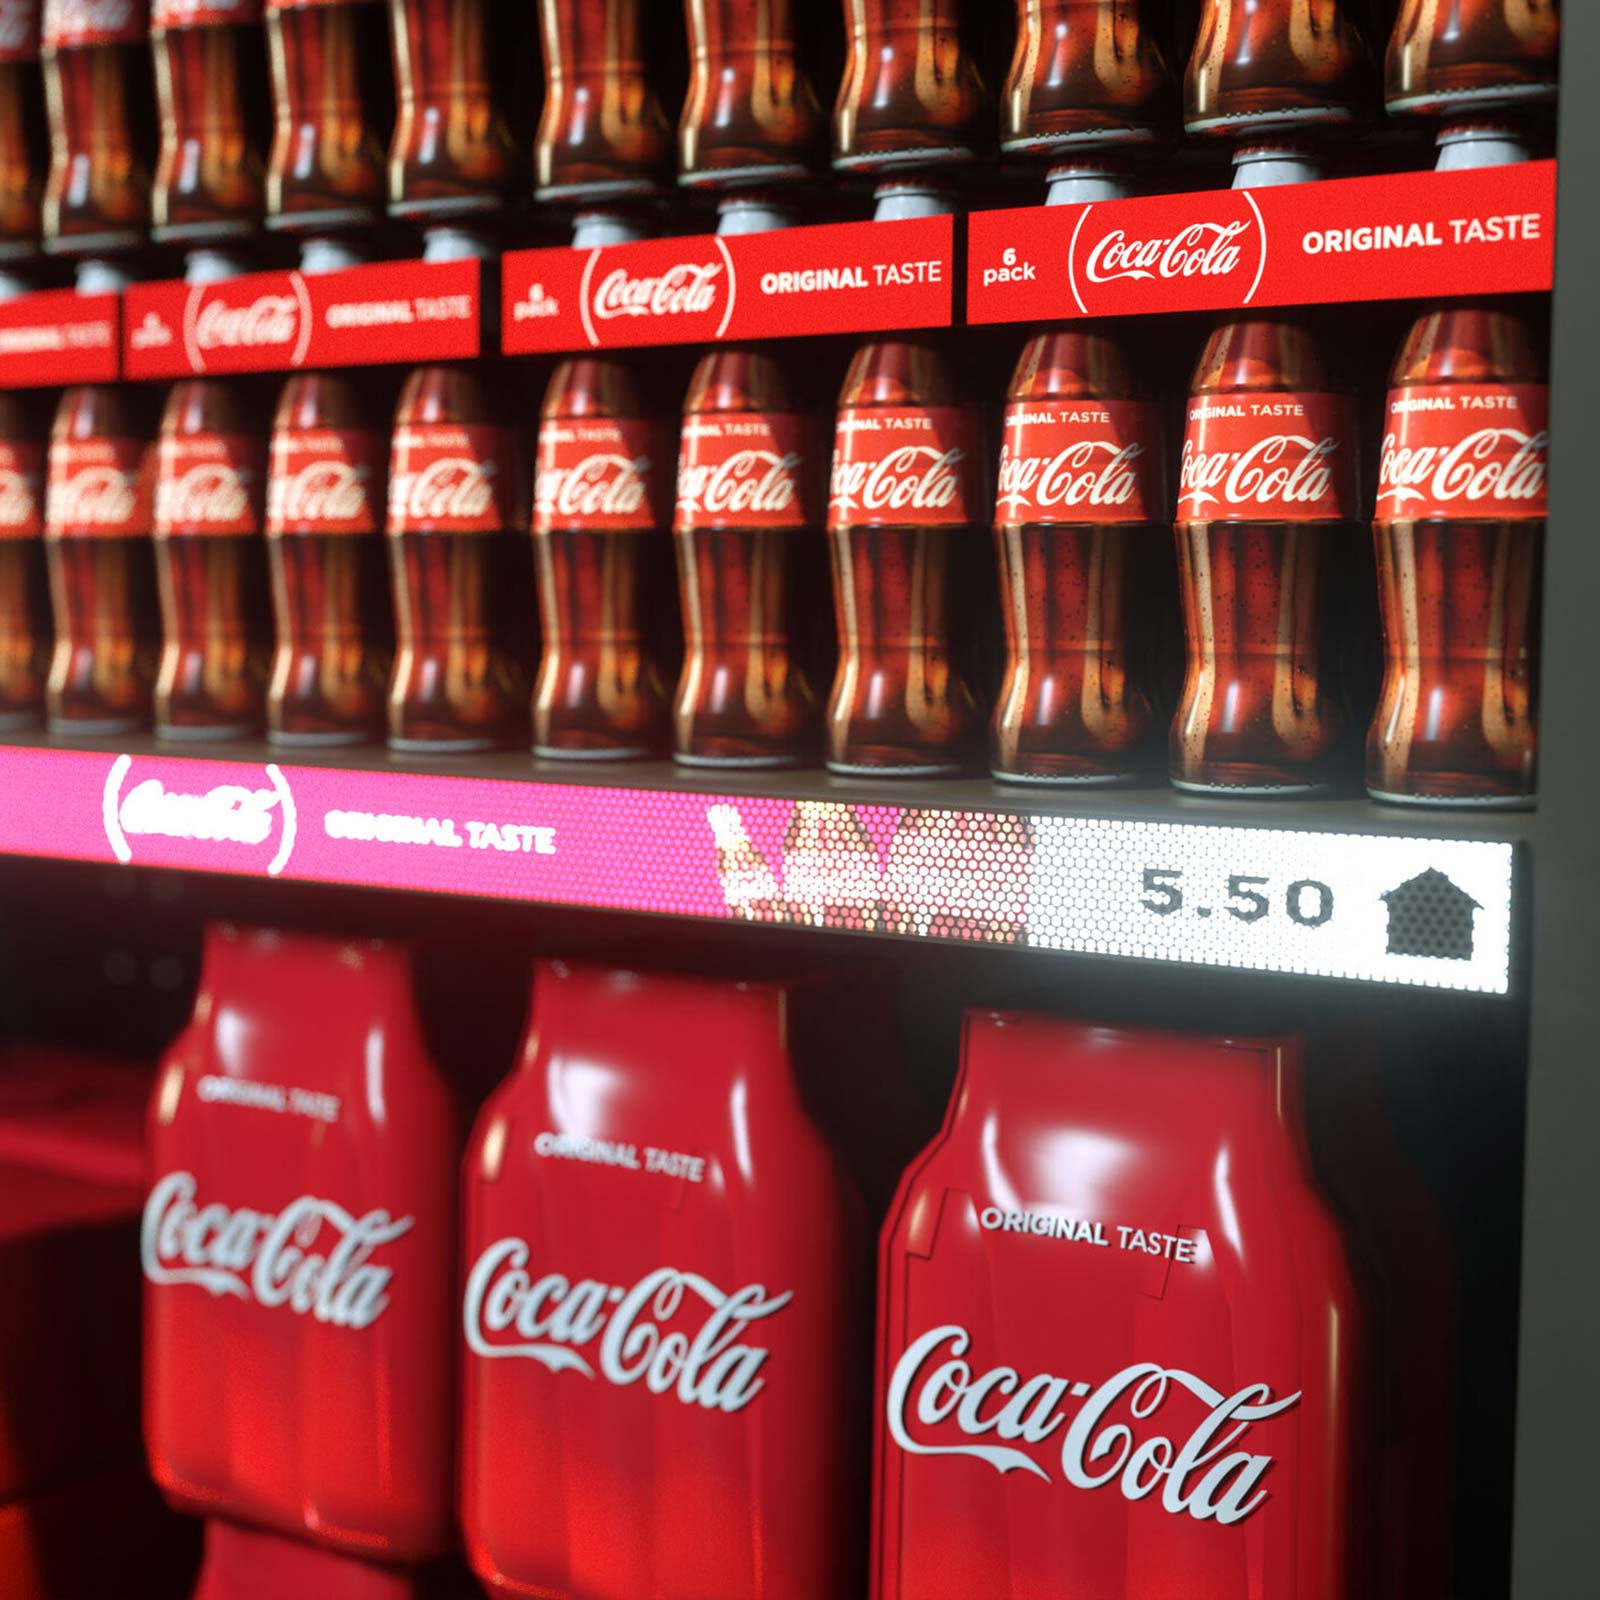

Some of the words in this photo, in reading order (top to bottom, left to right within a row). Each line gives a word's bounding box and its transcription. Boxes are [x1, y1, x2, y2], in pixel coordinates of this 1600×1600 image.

[1086, 220, 1251, 283] Coca-Cola
[1303, 222, 1442, 254] ORIGINAL
[1449, 213, 1541, 244] TASTE
[983, 262, 1036, 286] pack
[1002, 248, 1017, 266] 6
[760, 266, 869, 294] ORIGINAL
[873, 260, 942, 286] TASTE
[1060, 411, 1110, 424] TASTE
[1250, 404, 1304, 417] TASTE
[1460, 395, 1518, 410] TASTE
[884, 417, 933, 430] TASTE
[465, 821, 557, 854] TASTE
[1138, 868, 1334, 929] 5.50
[534, 1131, 640, 1170] ORIGINAL
[643, 1146, 706, 1183] TASTE
[141, 1171, 414, 1329] Coca-Cola
[981, 1207, 1109, 1246] ORIGINAL
[1116, 1226, 1198, 1263] TASTE
[464, 1238, 793, 1413] Coca-Cola
[887, 1325, 1302, 1524] Coca-Cola
